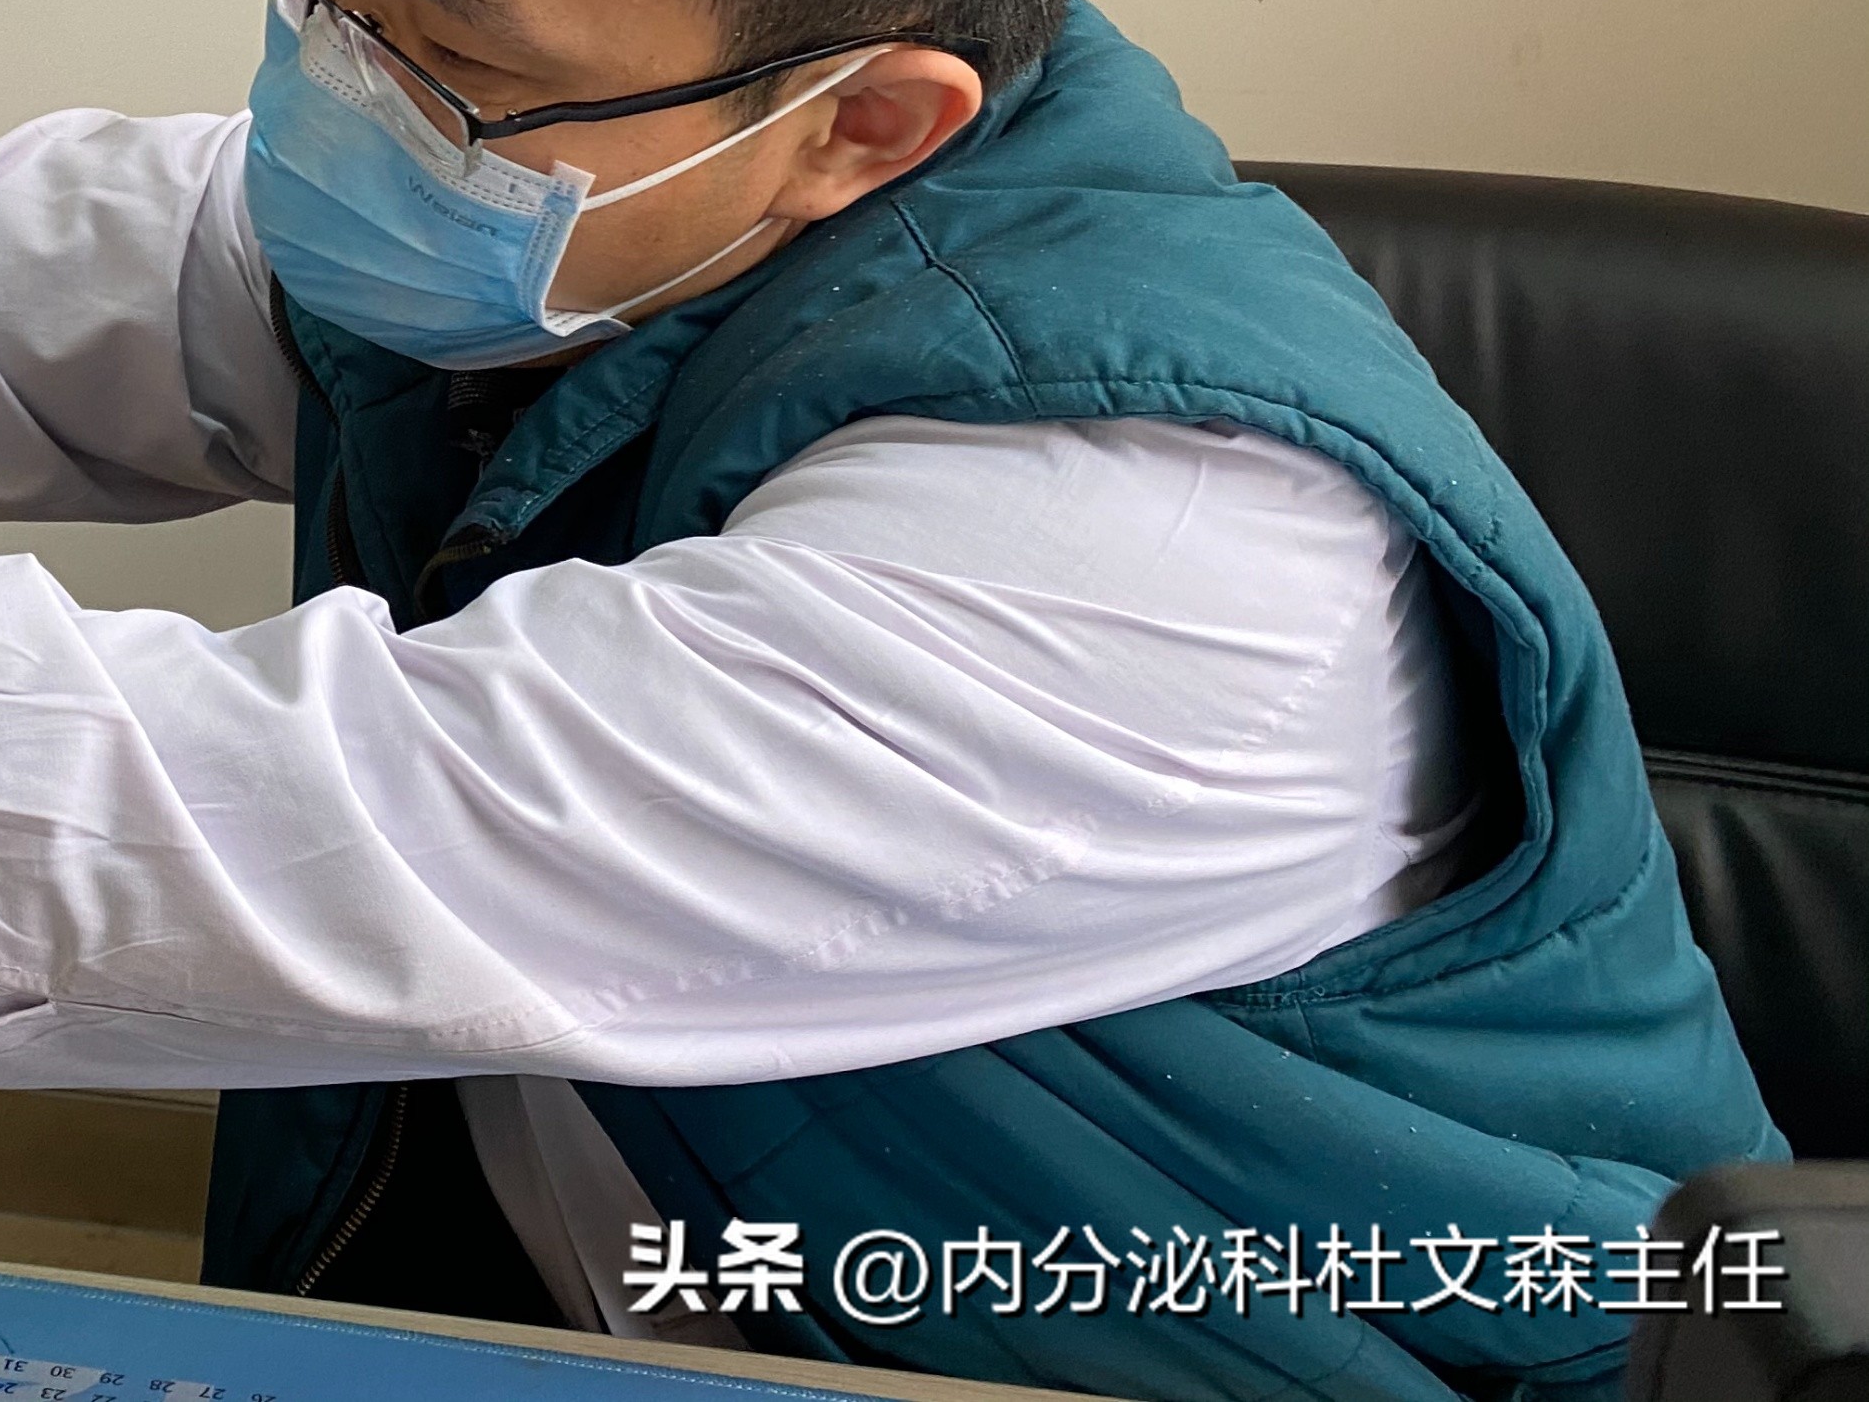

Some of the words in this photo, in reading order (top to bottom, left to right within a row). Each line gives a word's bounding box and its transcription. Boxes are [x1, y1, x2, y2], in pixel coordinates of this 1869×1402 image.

[3, 1358, 28, 1372] 31
[50, 1365, 76, 1379] 30
[99, 1372, 125, 1386] 29
[149, 1379, 176, 1393] 28
[40, 1387, 67, 1401] 23
[198, 1386, 226, 1400] 27
